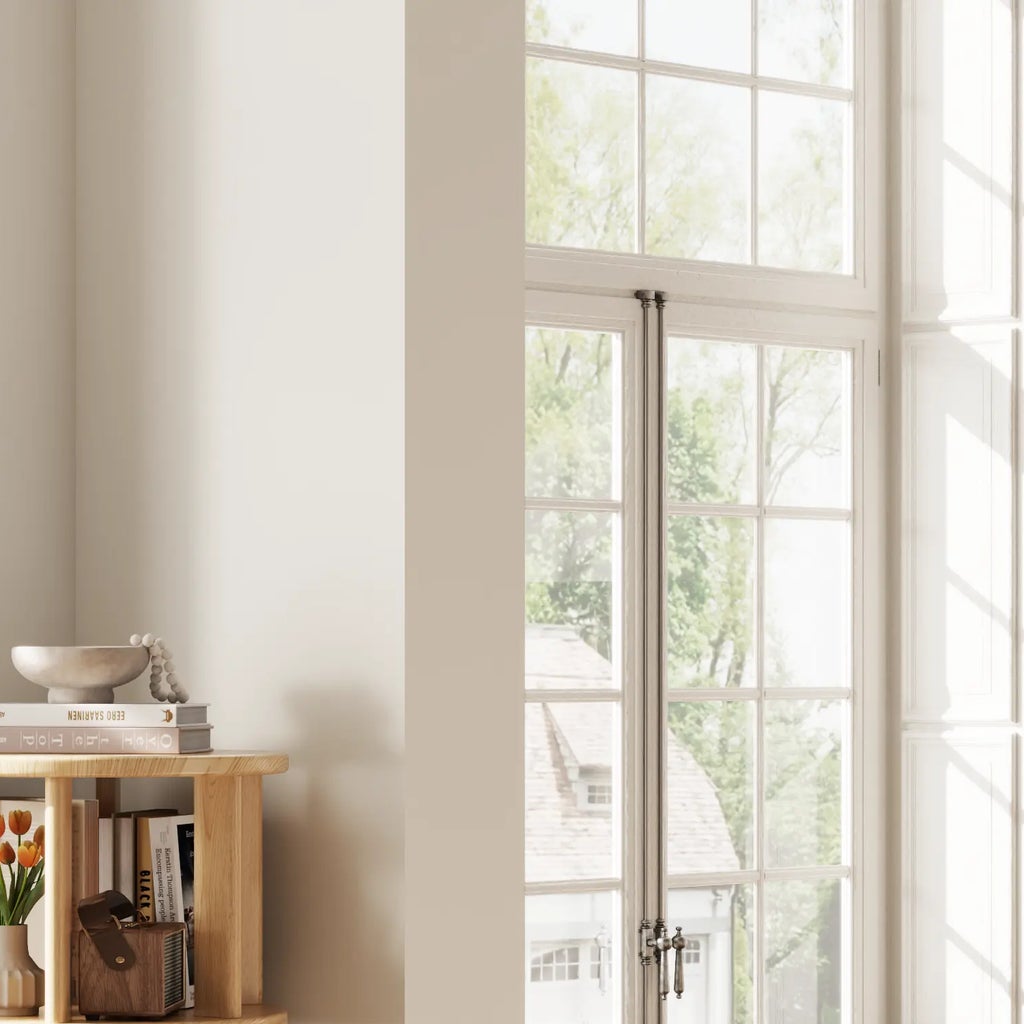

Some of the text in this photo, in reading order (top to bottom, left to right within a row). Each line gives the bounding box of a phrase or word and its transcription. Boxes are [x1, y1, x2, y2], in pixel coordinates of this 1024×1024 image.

[67, 709, 125, 721] EERO SAARINEN
[139, 869, 151, 909] BLACK
